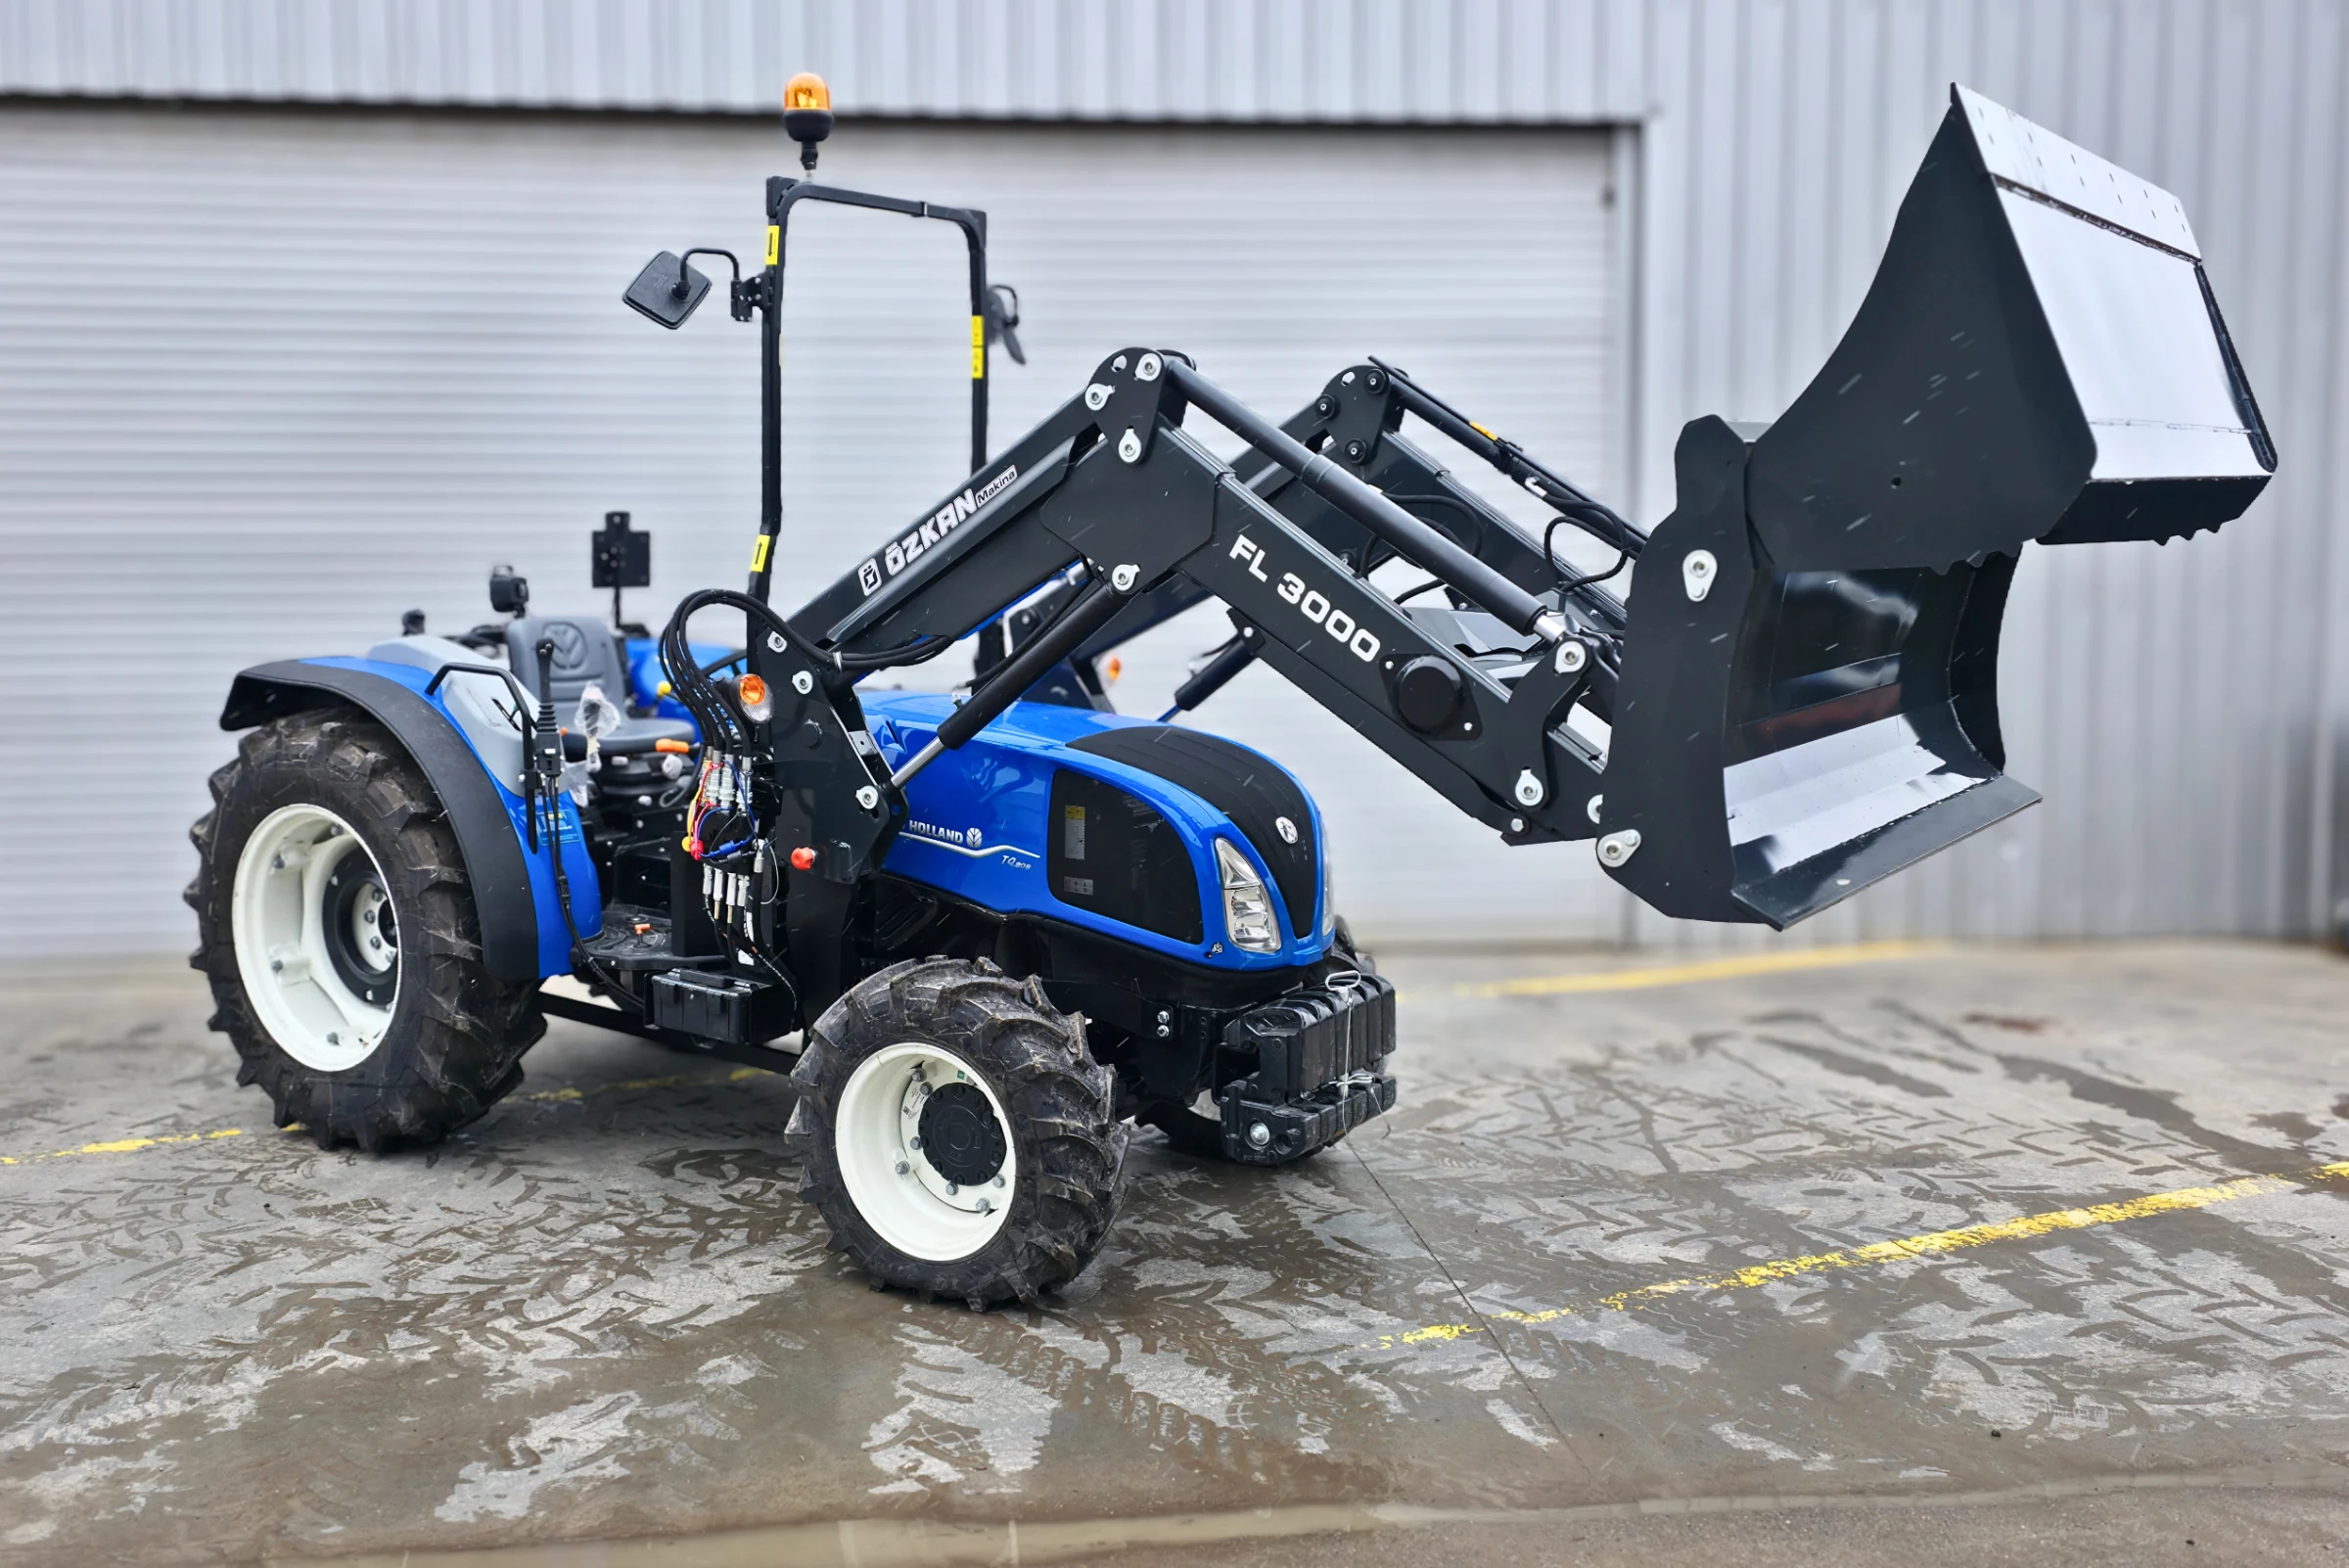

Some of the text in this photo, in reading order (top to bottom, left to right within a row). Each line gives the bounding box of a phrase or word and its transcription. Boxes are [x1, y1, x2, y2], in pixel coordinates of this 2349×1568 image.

[885, 487, 978, 576] ÖZKAN
[977, 469, 1016, 505] Makina
[1228, 533, 1381, 663] FL 3000
[908, 819, 964, 844] HOLLAND
